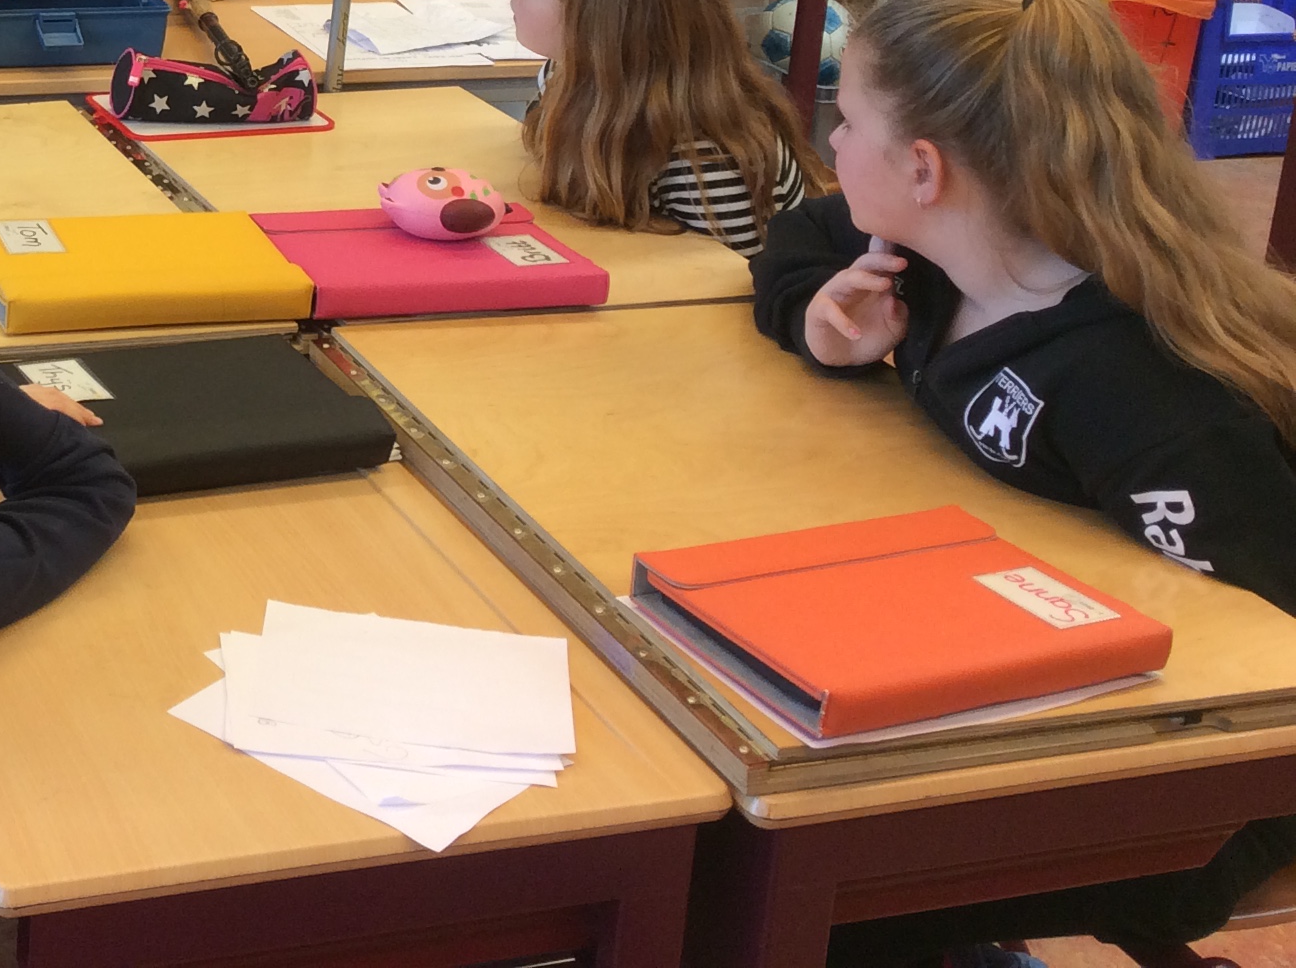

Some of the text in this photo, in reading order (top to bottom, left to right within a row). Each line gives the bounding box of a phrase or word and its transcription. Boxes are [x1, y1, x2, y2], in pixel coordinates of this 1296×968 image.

[16, 223, 48, 247] Tom
[996, 372, 1035, 415] TERRIERS
[1004, 573, 1090, 622] Sanne
